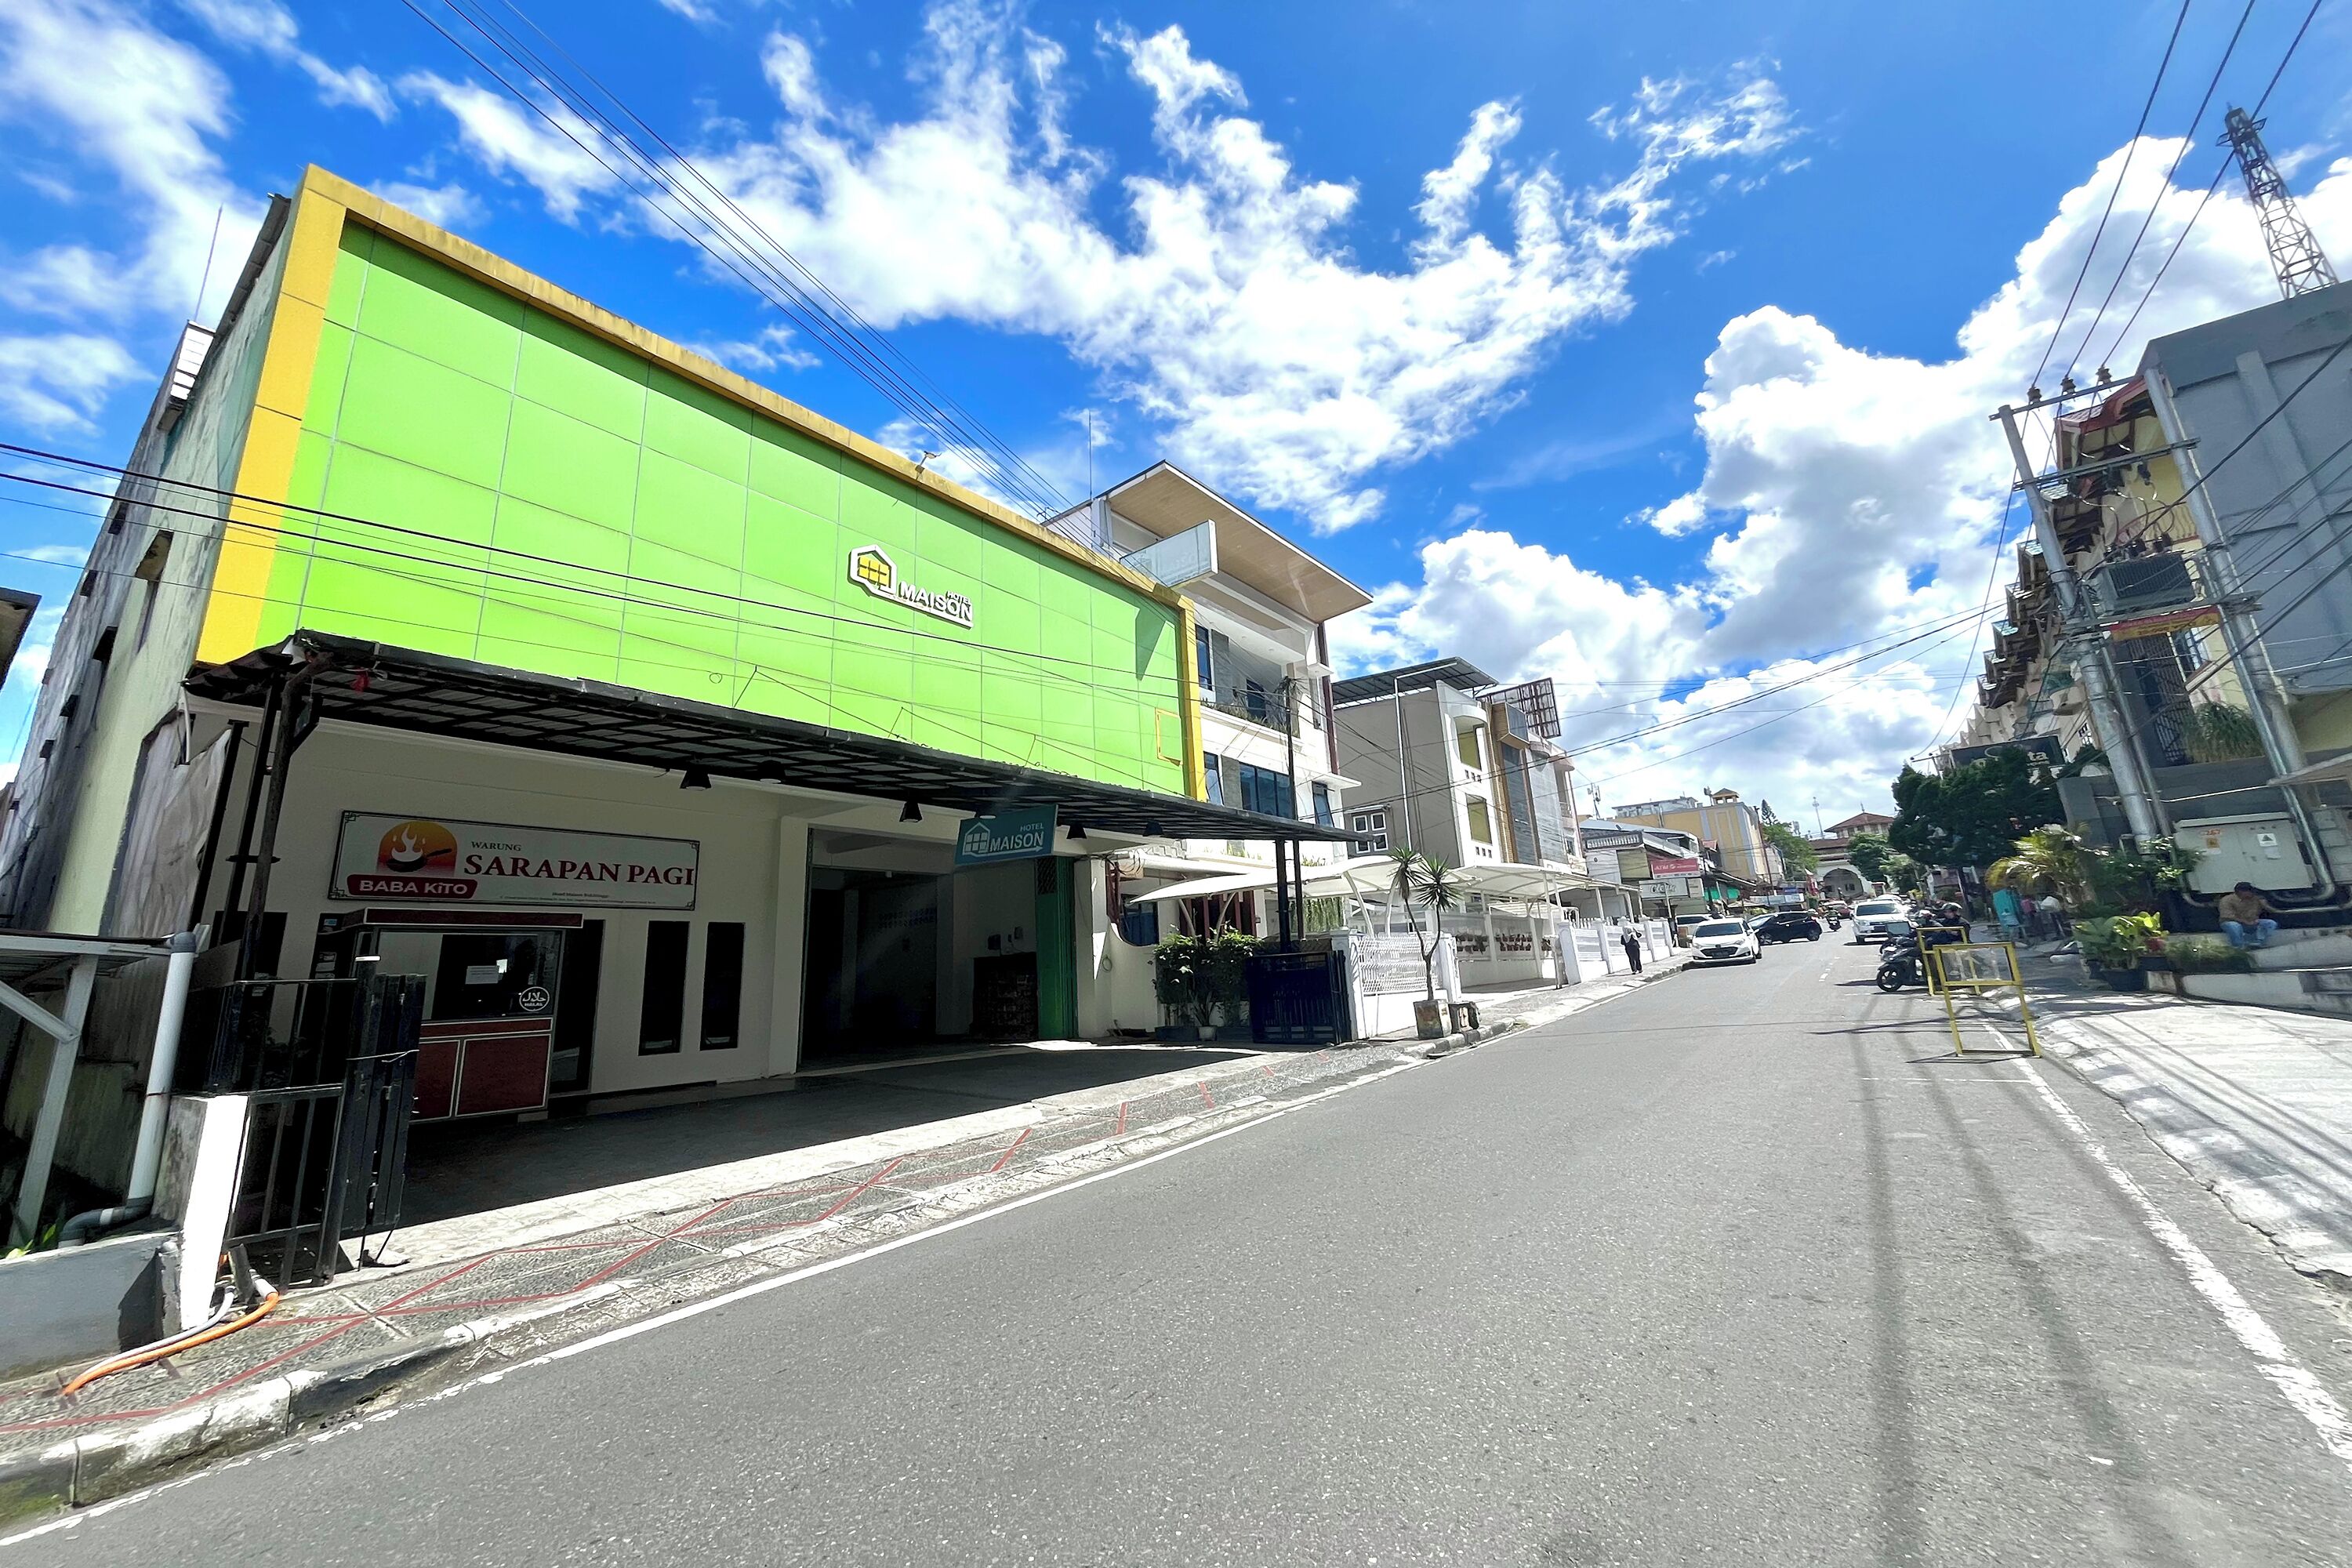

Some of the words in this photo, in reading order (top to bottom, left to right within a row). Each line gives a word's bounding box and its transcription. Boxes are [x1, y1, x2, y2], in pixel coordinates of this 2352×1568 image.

[900, 580, 973, 622] MAISON
[946, 590, 971, 604] HOTEL
[1020, 822, 1044, 832] HOTEL
[470, 841, 522, 852] WARUNG
[989, 831, 1044, 852] MAISON
[463, 854, 622, 883] SARAPAN
[627, 864, 695, 886] PAGI
[359, 880, 419, 893] BABA
[521, 991, 546, 1002] حلال
